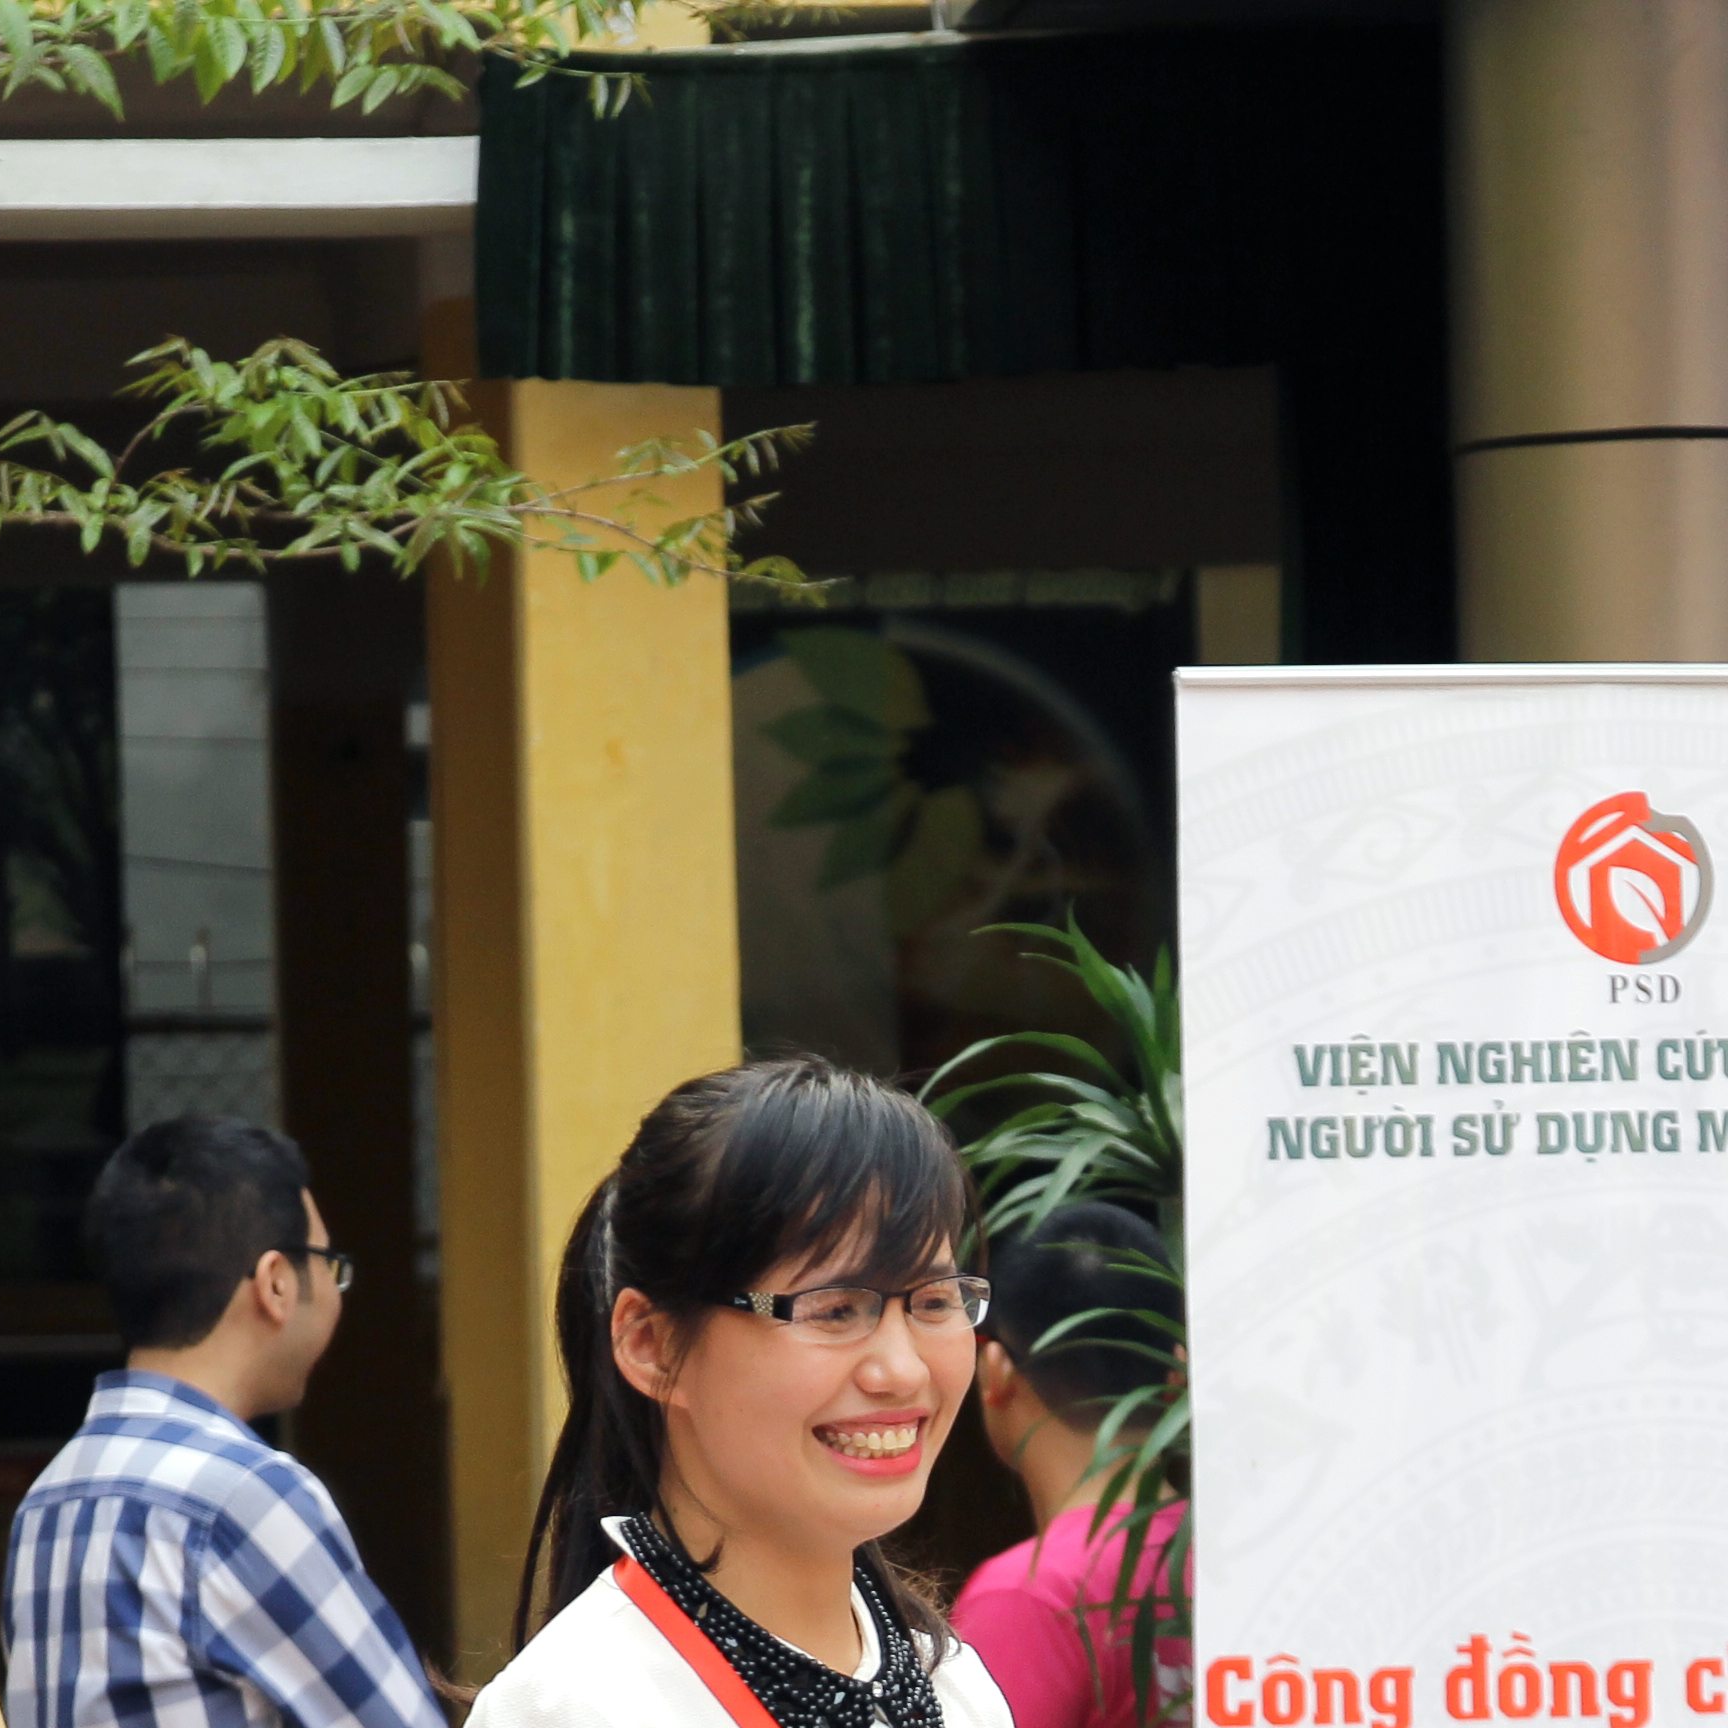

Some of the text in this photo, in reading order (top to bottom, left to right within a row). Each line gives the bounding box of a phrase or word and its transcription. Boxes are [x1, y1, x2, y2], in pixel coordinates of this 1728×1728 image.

[1611, 976, 1680, 1003] PSD
[1293, 1035, 1418, 1095] VIỆN
[1437, 1031, 1638, 1084] NGHIÊN
[1268, 1107, 1434, 1160] NGƯỜI
[1452, 1101, 1519, 1156] SỬ
[1536, 1111, 1680, 1162] DỤNG
